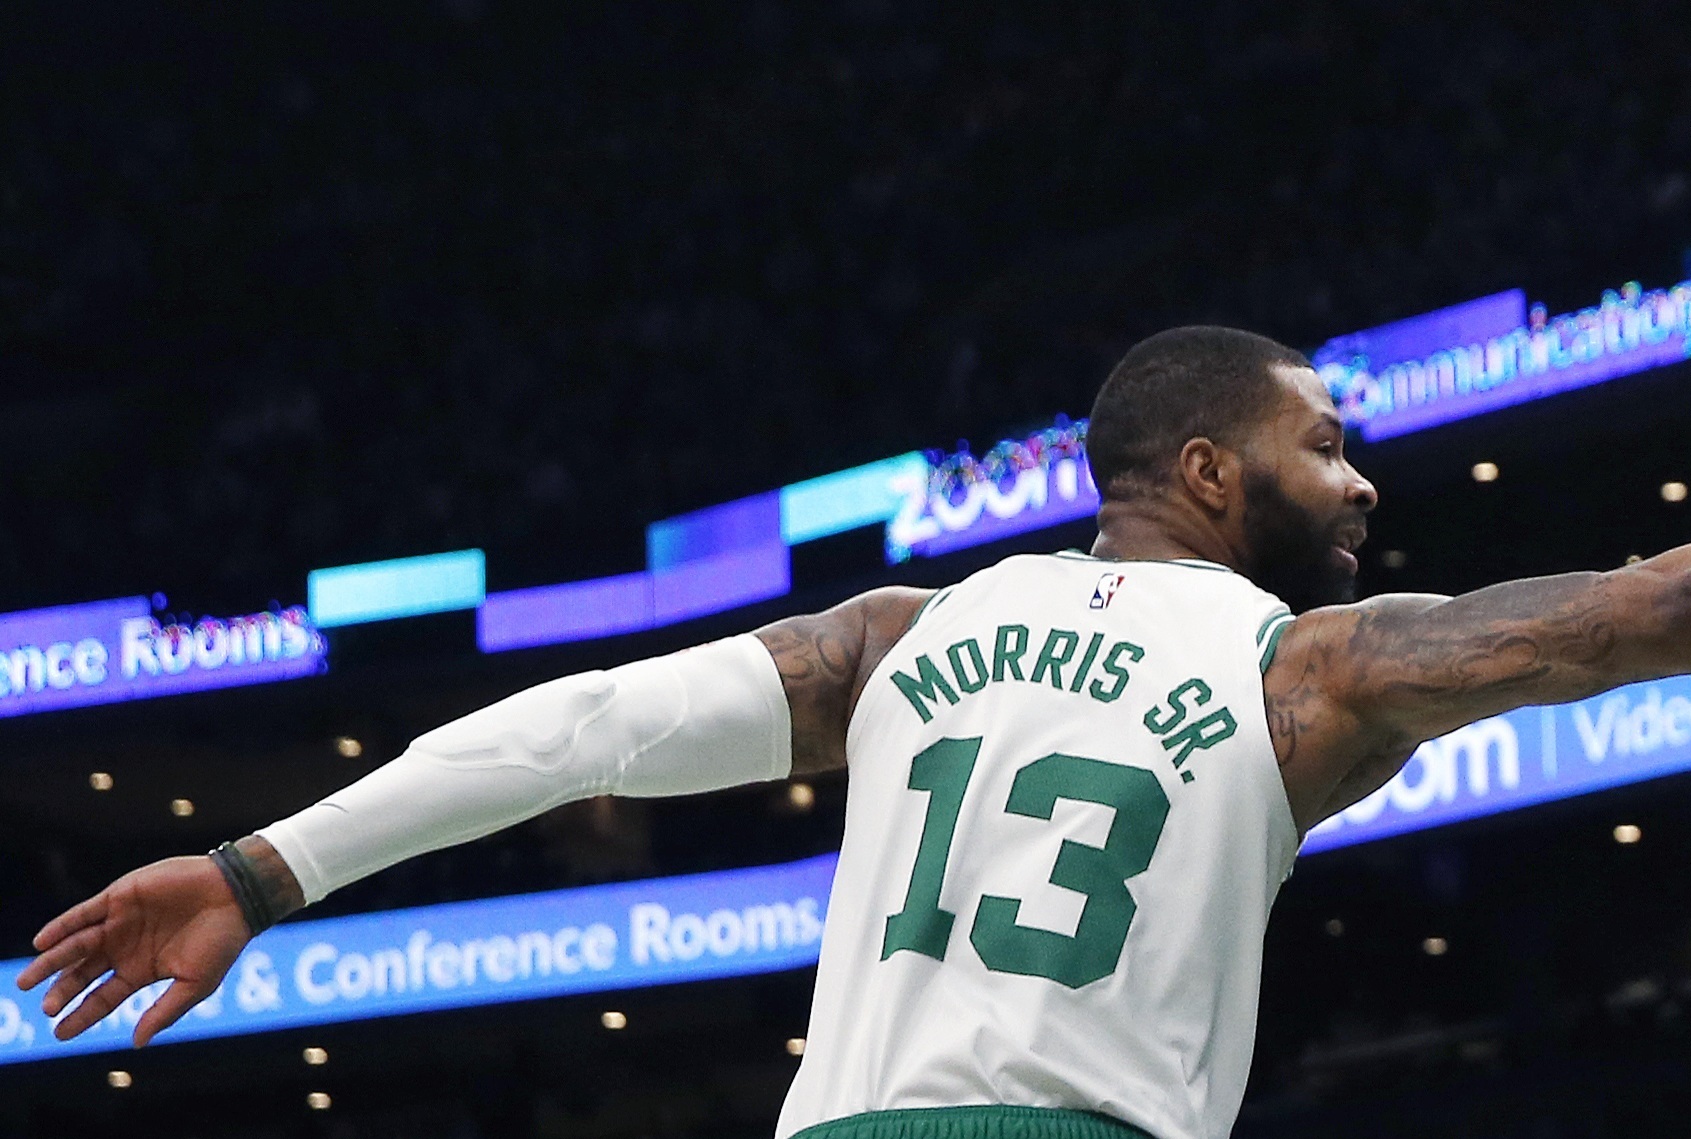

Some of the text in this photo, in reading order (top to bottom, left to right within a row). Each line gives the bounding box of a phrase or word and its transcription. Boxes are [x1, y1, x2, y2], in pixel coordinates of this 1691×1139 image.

[889, 623, 1239, 785] MORRIS SR.
[879, 735, 1172, 990] 13
[236, 949, 283, 1014] &
[295, 928, 619, 1005] Conference
